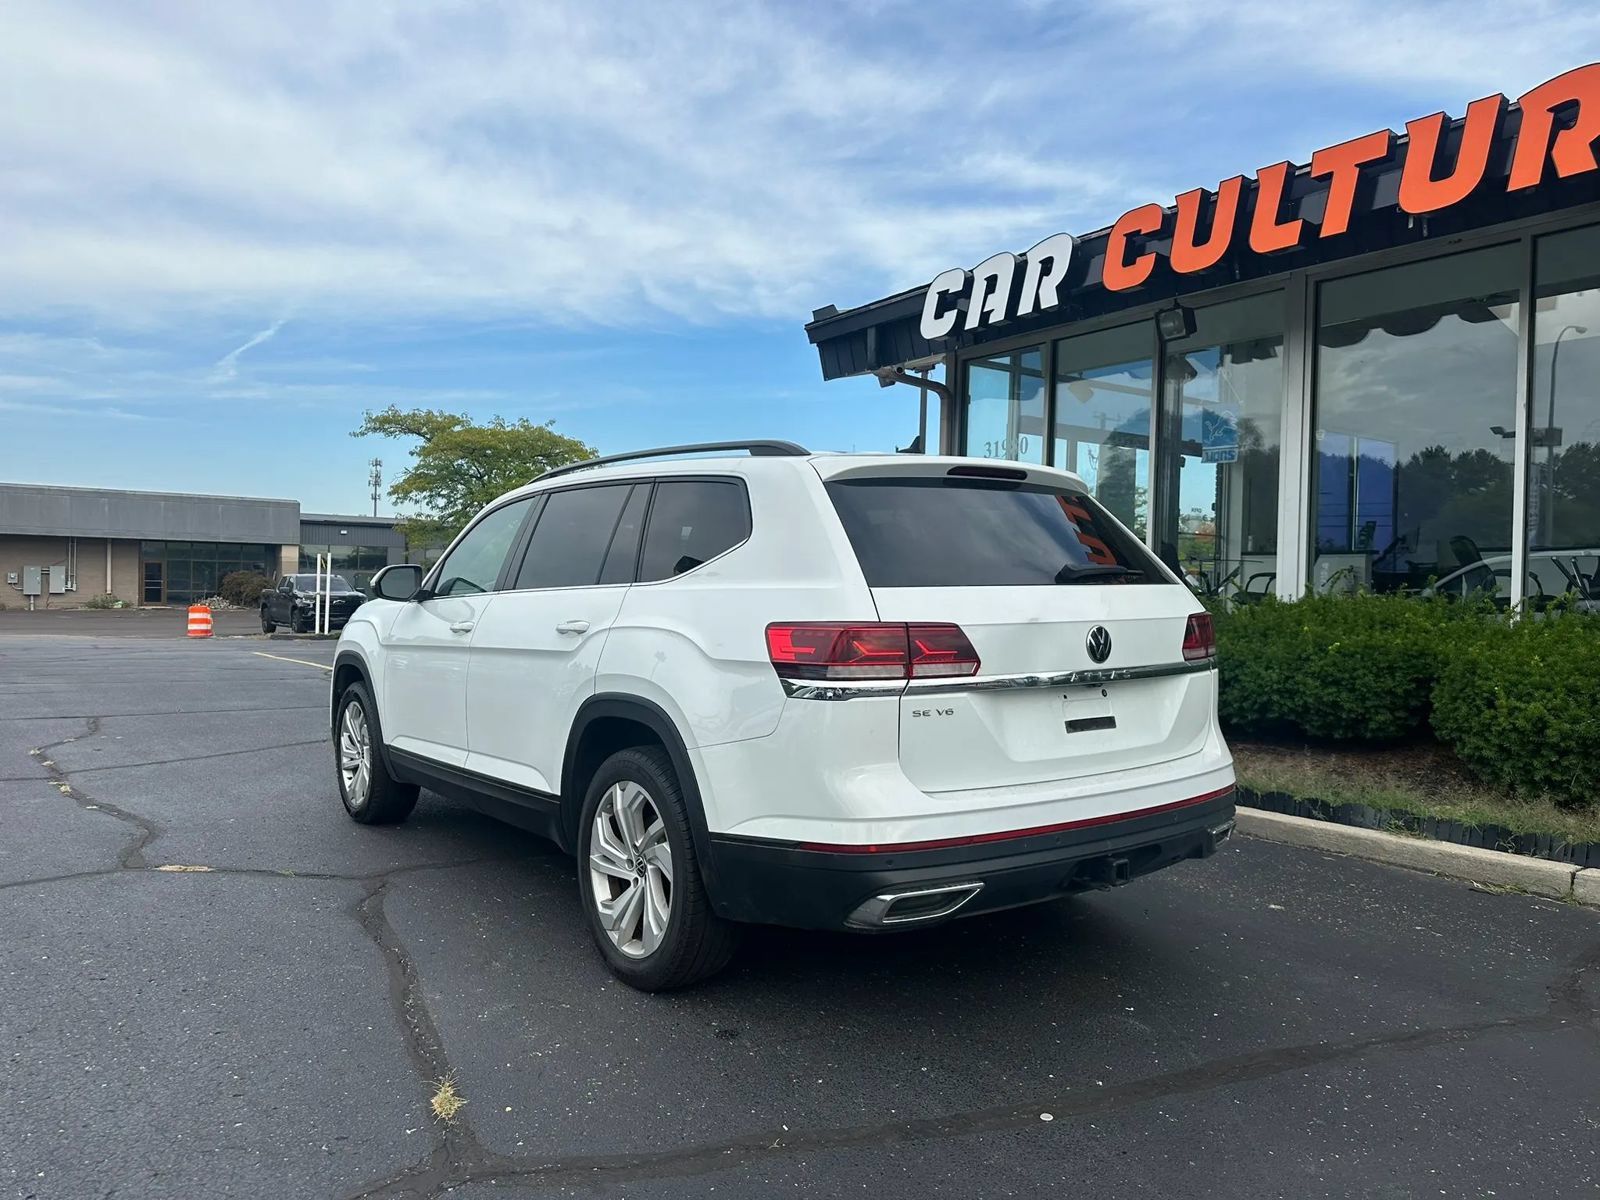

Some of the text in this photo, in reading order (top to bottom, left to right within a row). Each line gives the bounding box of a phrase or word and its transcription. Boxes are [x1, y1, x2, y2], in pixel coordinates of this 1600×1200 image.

[919, 62, 1600, 341] CAR CULTUR
[912, 707, 955, 718] SE V6
